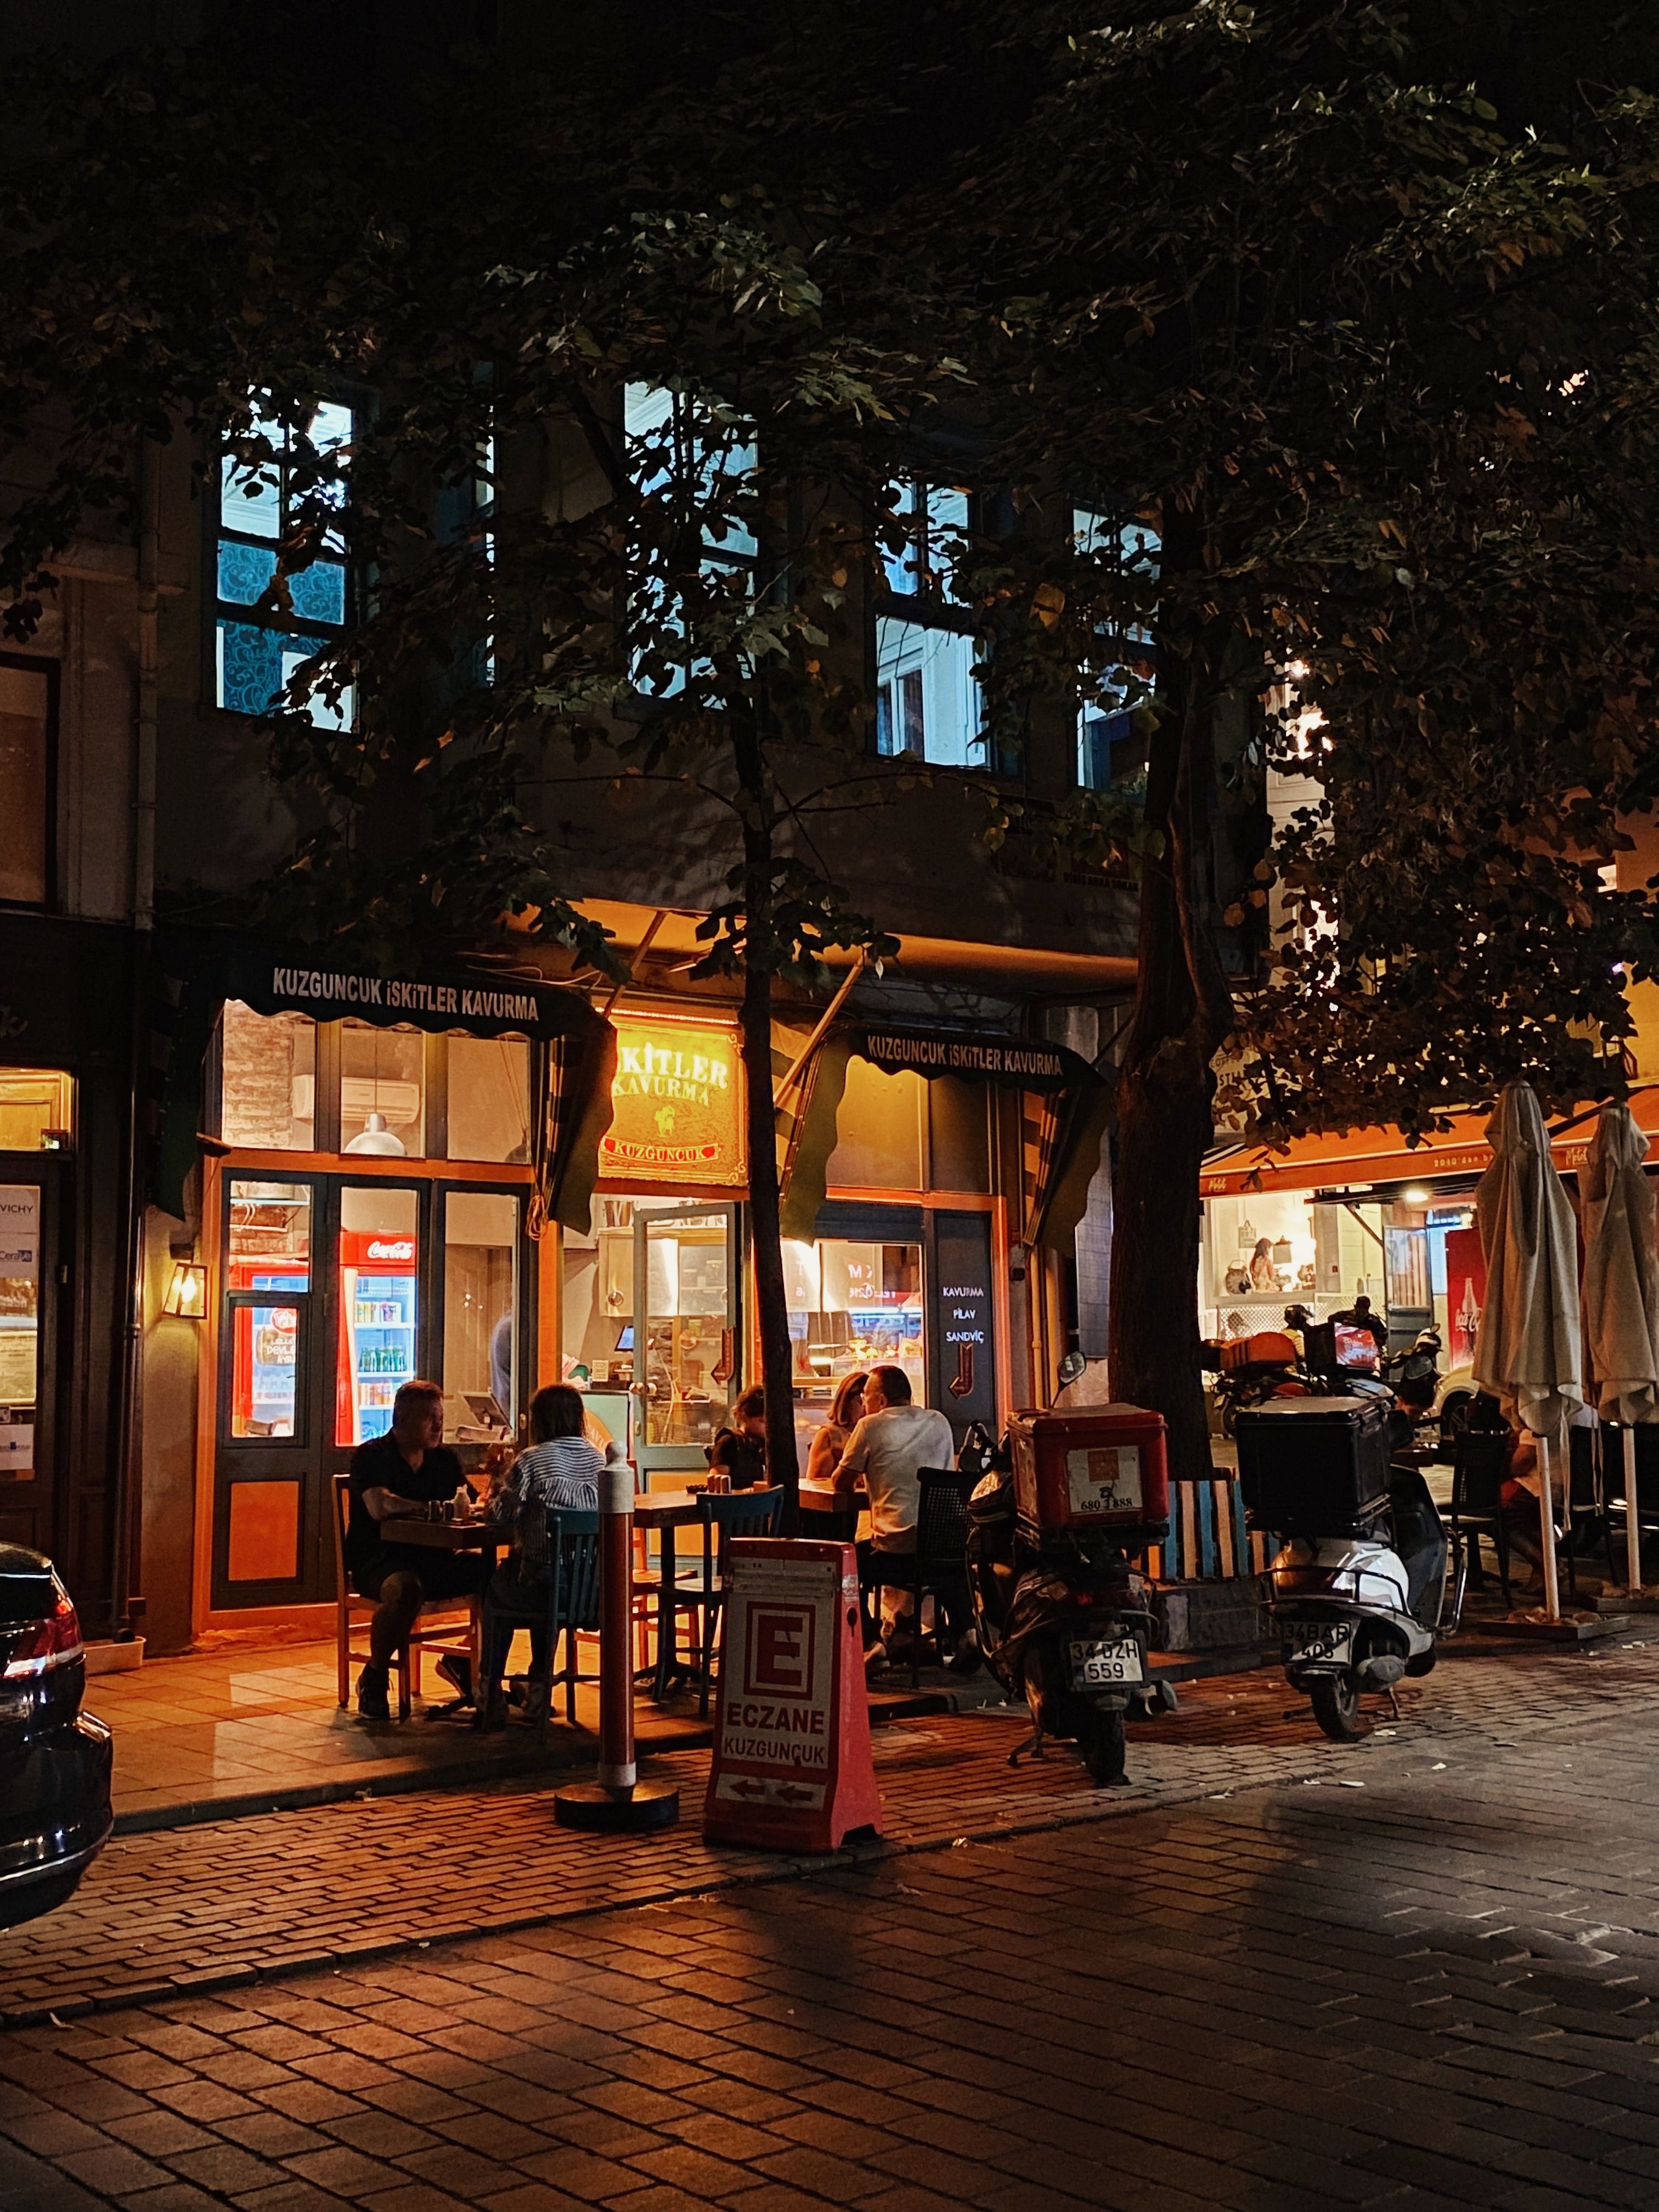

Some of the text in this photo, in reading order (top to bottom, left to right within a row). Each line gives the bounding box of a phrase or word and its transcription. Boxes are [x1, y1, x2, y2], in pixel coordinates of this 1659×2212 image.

[273, 967, 382, 1005] KUZGUNCUK
[461, 990, 539, 1022] KAVURMA
[868, 1035, 946, 1065] KUZGUNCUK
[1005, 1049, 1063, 1076] KAVURMA
[618, 1042, 728, 1090] KİTLER
[612, 1074, 709, 1107] KAVURMA
[614, 1142, 707, 1162] KUZGUNCUK
[0, 1204, 33, 1214] VICHY
[943, 1286, 984, 1297] KAVURMA
[953, 1307, 976, 1319] PİLAV
[946, 1329, 984, 1344] SANDVİÇ
[1081, 1500, 1101, 1511] 680
[755, 1615, 804, 1686] E
[1071, 1642, 1137, 1660] 34 DZH
[1088, 1662, 1124, 1679] 559
[726, 1702, 825, 1735] ECZANE
